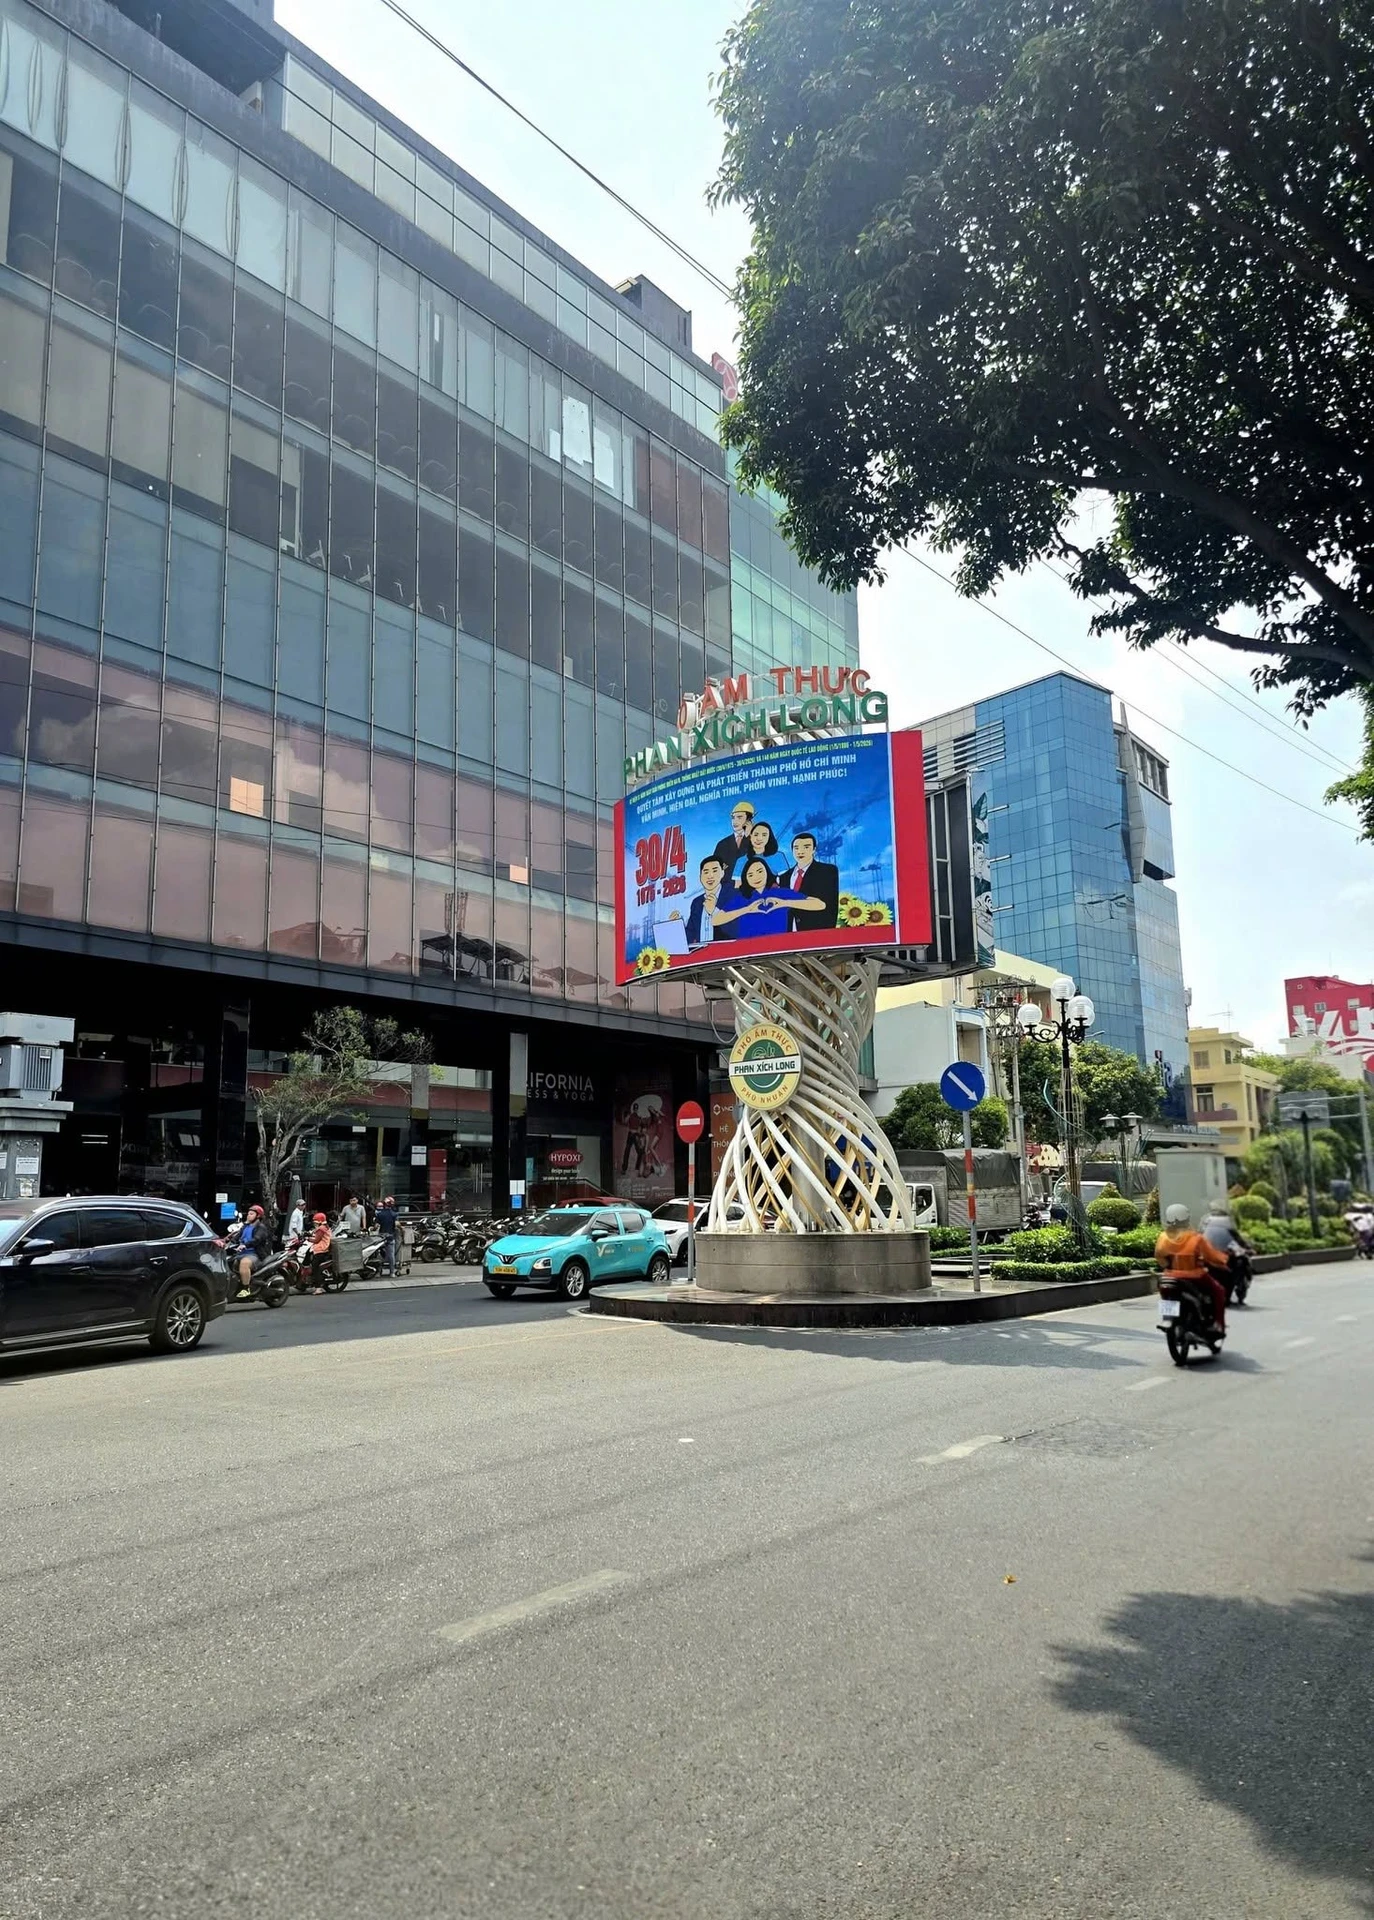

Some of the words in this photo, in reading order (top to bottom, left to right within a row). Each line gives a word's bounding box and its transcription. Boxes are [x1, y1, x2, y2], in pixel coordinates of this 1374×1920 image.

[624, 732, 684, 784] PHAN
[780, 691, 888, 734] LONG
[665, 789, 677, 802] XÂY
[677, 785, 695, 798] DỰNG
[696, 780, 705, 792] VÀ
[706, 776, 725, 789] PHÁT
[750, 764, 777, 778] THÀNH
[780, 759, 797, 773] PHỐ
[814, 755, 829, 767] CHÍ
[832, 754, 857, 766] MINH
[699, 789, 720, 803] NGHĨA
[722, 785, 742, 798] TÌNH,
[768, 776, 790, 788] VINH,
[793, 772, 817, 784] HẠNH
[820, 768, 847, 780] PHÚC!
[635, 825, 687, 887] 30/4
[771, 1030, 791, 1051] THỰC
[734, 1064, 755, 1074] PHAN
[756, 1061, 773, 1072] XÍCH
[775, 1060, 795, 1070] LONG
[527, 1072, 593, 1091] IFORNIA
[564, 1091, 594, 1102] YOGA
[551, 1153, 581, 1162] HYPOXI
